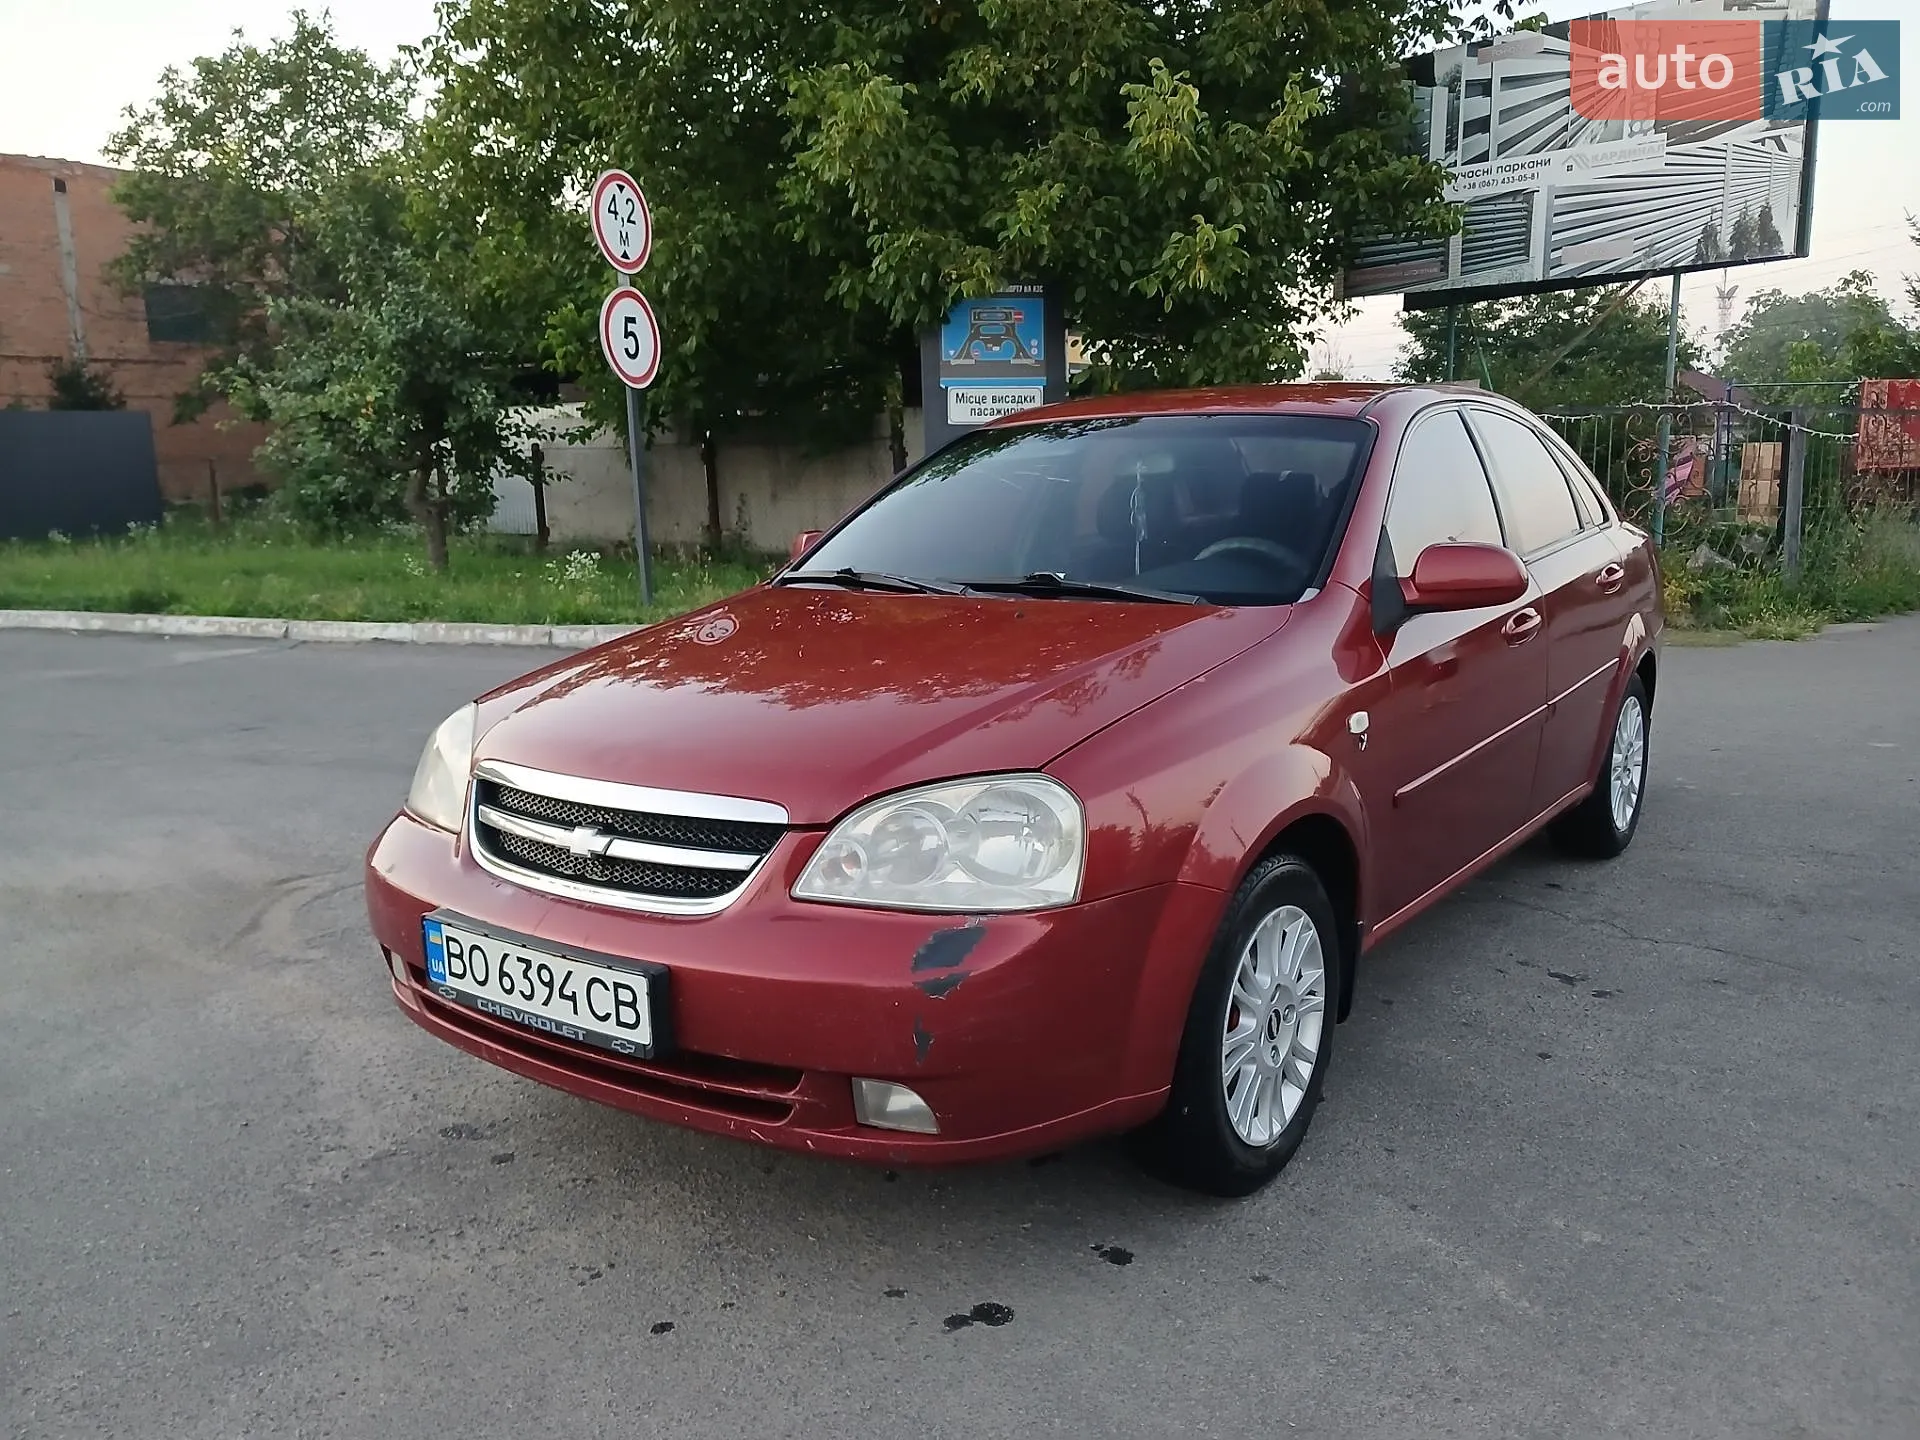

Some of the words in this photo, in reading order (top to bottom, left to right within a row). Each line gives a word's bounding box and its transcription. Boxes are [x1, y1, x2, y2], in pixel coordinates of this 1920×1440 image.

[1454, 165, 1493, 183] учасні
[1496, 157, 1552, 176] паркани
[1462, 181, 1477, 190] +38
[1478, 178, 1499, 189] (067)
[1500, 172, 1540, 185] 433-05-81
[607, 193, 637, 228] 4,2
[623, 315, 640, 360] 5
[955, 392, 987, 407] Місце
[991, 393, 1036, 406] висадки
[970, 406, 1025, 418] пасажирі
[431, 958, 445, 976] UA
[444, 935, 490, 987] BO
[498, 952, 579, 1016] 6394
[586, 976, 641, 1030] CB
[476, 999, 588, 1042] CHEVROLET
